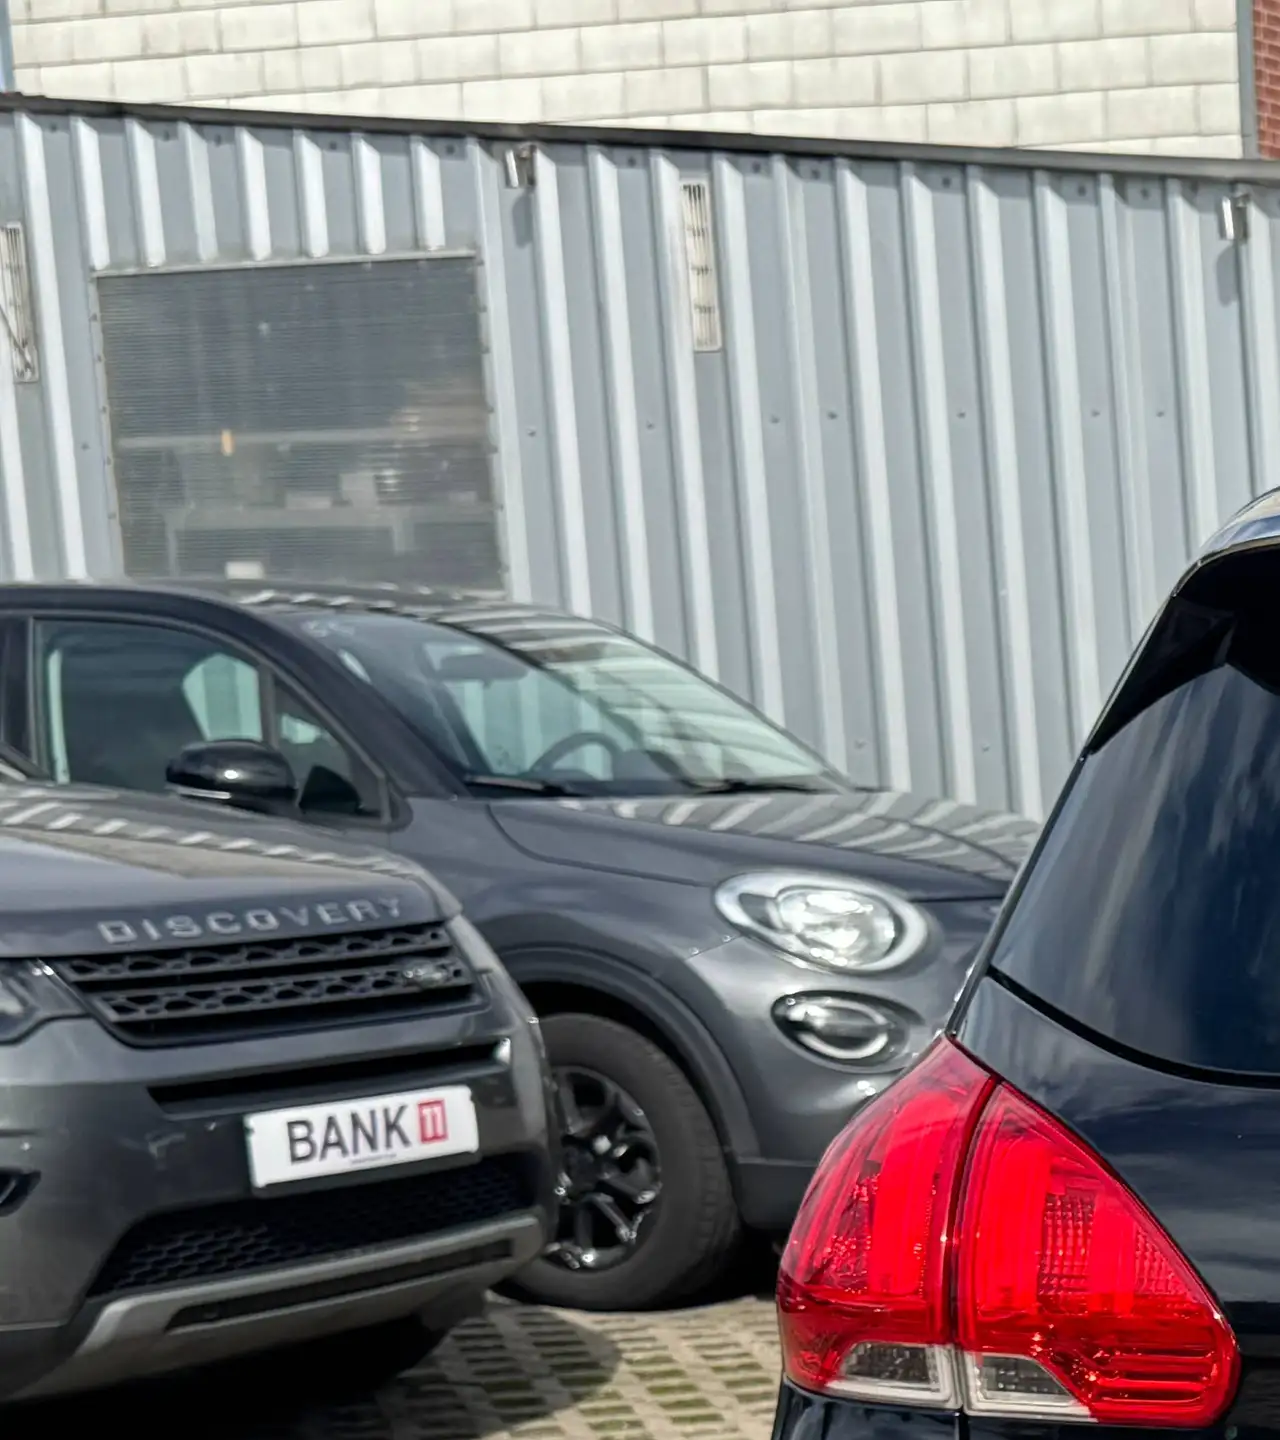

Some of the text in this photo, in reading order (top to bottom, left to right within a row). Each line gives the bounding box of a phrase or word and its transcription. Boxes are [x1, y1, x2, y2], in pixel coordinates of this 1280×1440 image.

[97, 896, 400, 944] DISCOVERY
[286, 1101, 447, 1165] BANK 11
